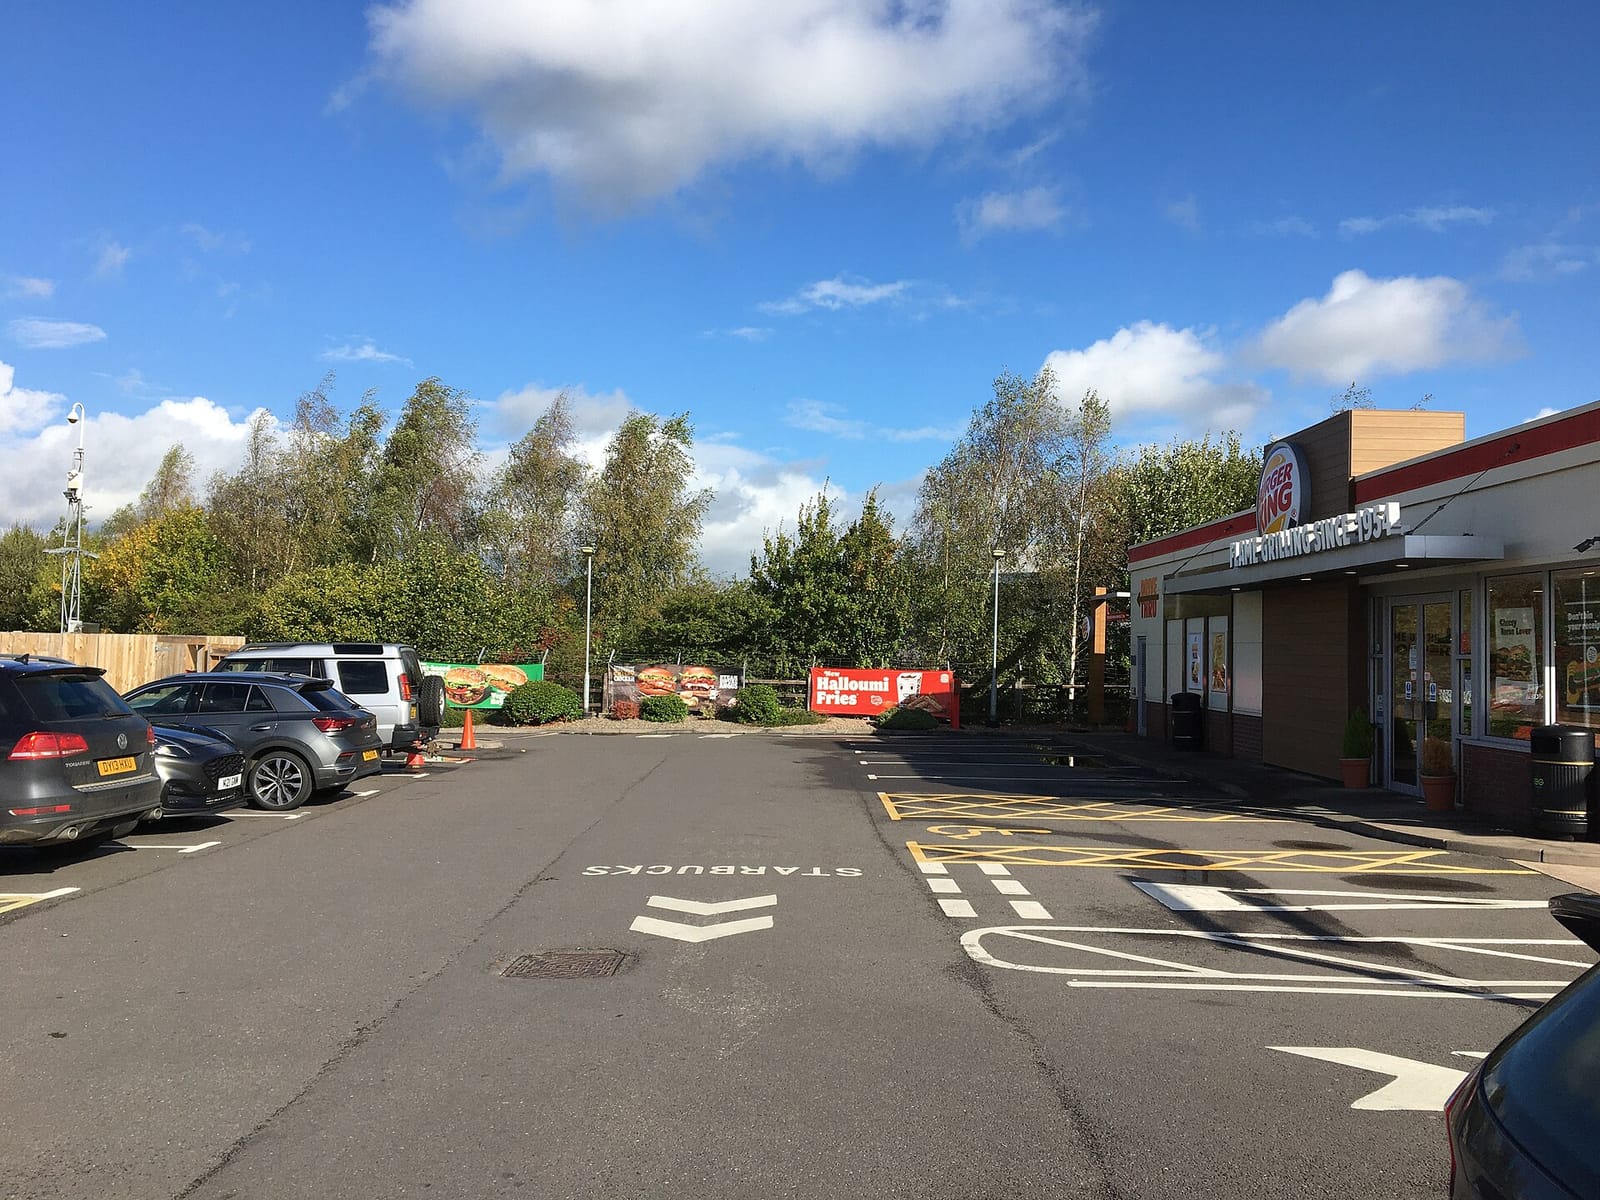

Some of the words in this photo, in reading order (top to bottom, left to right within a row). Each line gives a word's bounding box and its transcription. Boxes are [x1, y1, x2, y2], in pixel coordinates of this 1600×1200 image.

[1260, 481, 1293, 533] KING
[1229, 538, 1261, 569] FLAME
[1261, 523, 1311, 562] GRILLING
[1314, 514, 1352, 553] SINCE
[1357, 503, 1394, 543] 1954
[823, 670, 841, 678] New
[816, 676, 890, 693] Halloumi
[816, 690, 858, 706] Fries
[581, 864, 863, 878] STARBUCKS
